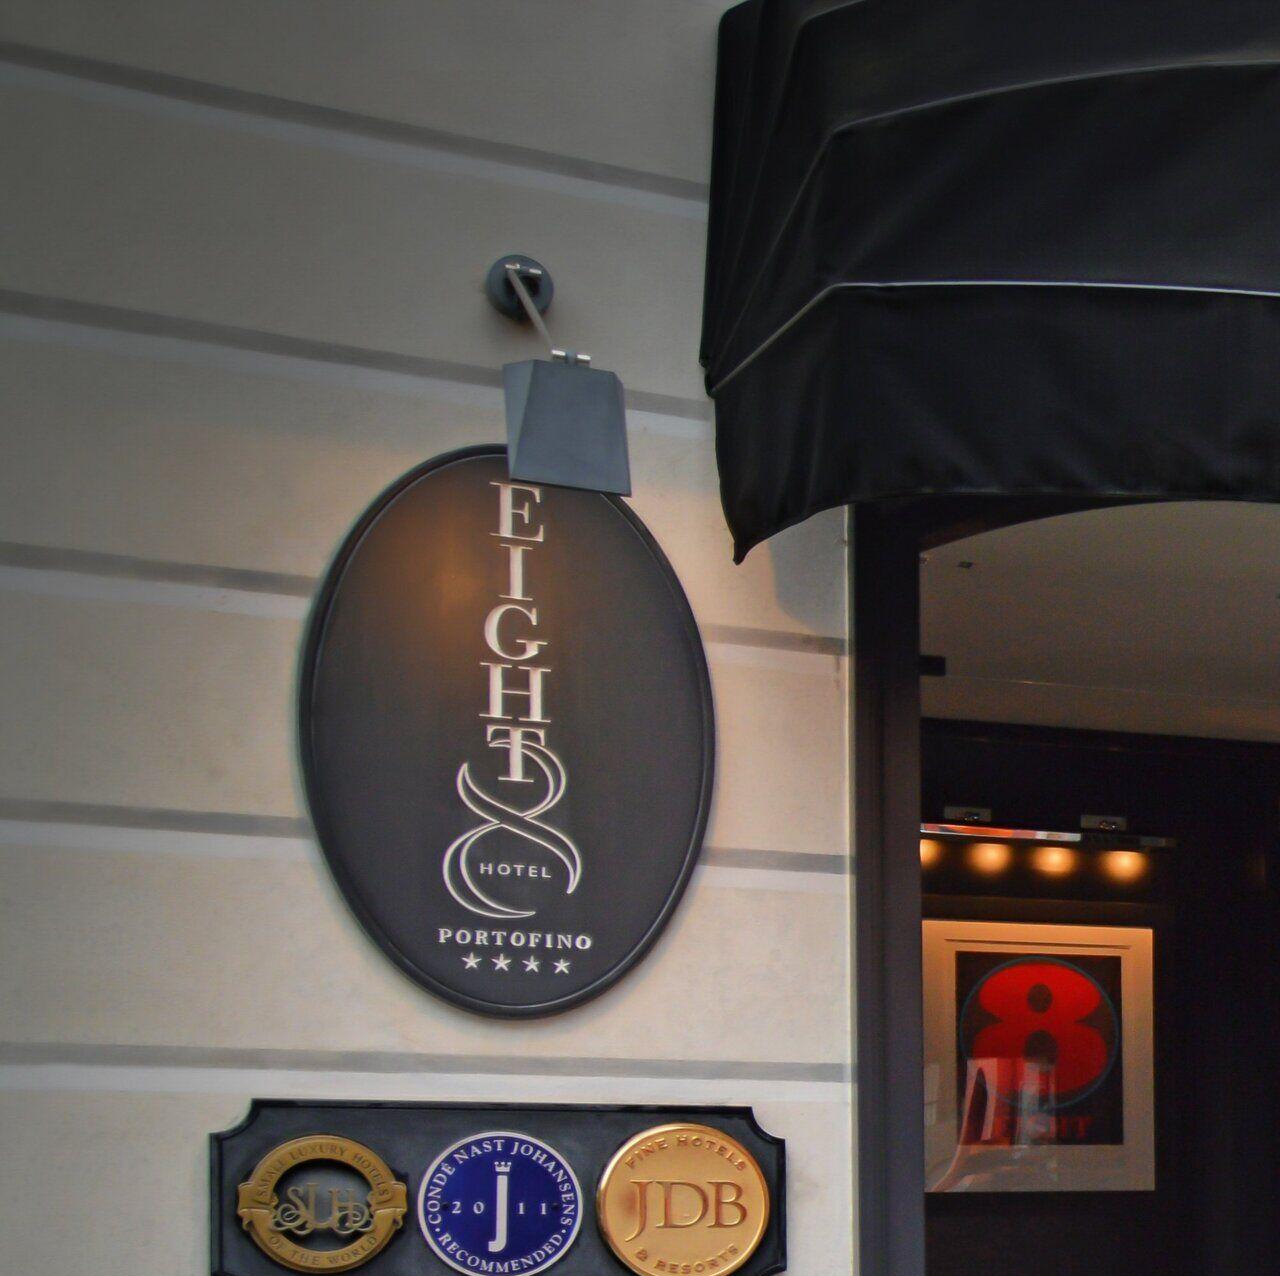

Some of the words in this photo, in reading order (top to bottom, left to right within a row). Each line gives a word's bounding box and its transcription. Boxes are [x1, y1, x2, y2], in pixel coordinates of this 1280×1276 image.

[479, 481, 551, 782] EIGHT
[479, 862, 552, 879] HOTEL
[438, 927, 593, 950] PORTOFINO
[972, 962, 1108, 1095] 8
[257, 1157, 288, 1198] SMALL
[289, 1144, 346, 1161] LUXURY
[353, 1152, 392, 1197] HOTELS
[625, 1137, 668, 1170] FINE
[676, 1133, 747, 1172] HOTELS
[453, 1139, 505, 1164] NAST
[510, 1141, 575, 1226] JOHANSENS
[624, 1179, 748, 1243] JDB
[269, 1235, 282, 1251] OF
[290, 1250, 321, 1266] THE
[327, 1235, 377, 1265] WORLD
[438, 1232, 563, 1273] RECOMMENDED
[635, 1246, 648, 1262] &
[654, 1242, 739, 1274] RESORTS
